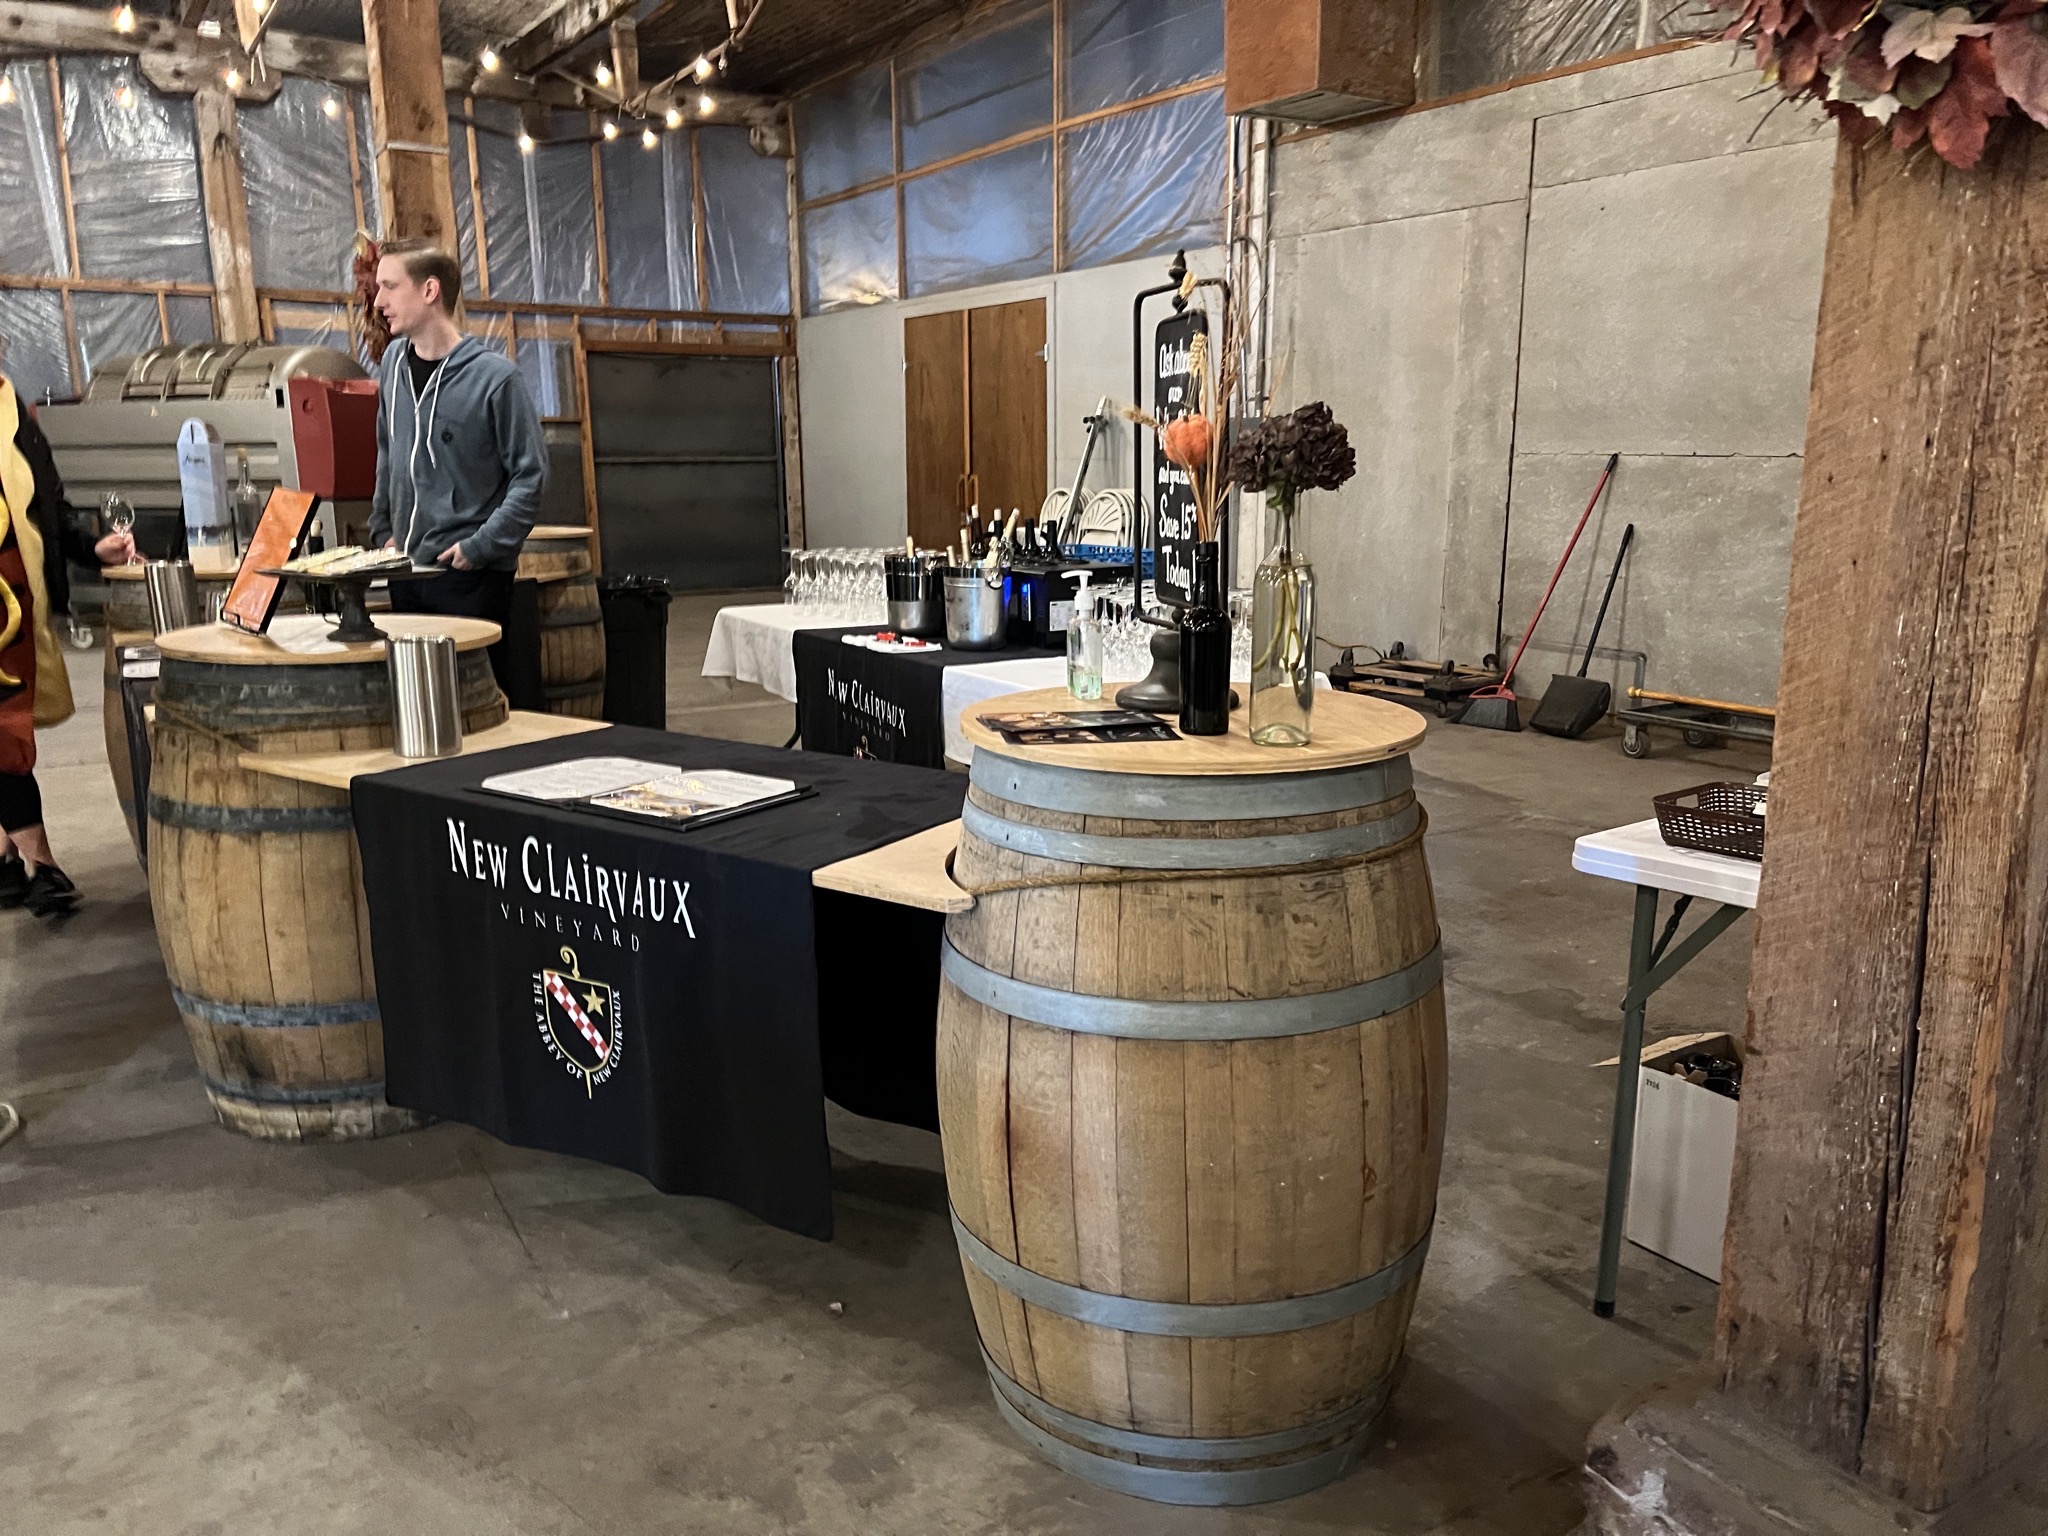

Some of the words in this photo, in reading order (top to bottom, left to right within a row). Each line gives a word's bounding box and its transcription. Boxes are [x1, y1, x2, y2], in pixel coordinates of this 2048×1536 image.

[1159, 343, 1174, 379] Ask
[1158, 460, 1169, 485] and
[1159, 492, 1180, 540] Save
[1181, 501, 1197, 540] 15%
[446, 817, 509, 890] NEW
[501, 902, 641, 953] VINEYARD
[532, 972, 544, 1006] THE
[535, 1011, 565, 1061] ABBEY
[609, 988, 624, 1068] CLAIRVAUX
[566, 1061, 584, 1080] OF
[592, 1065, 612, 1086] NEW
